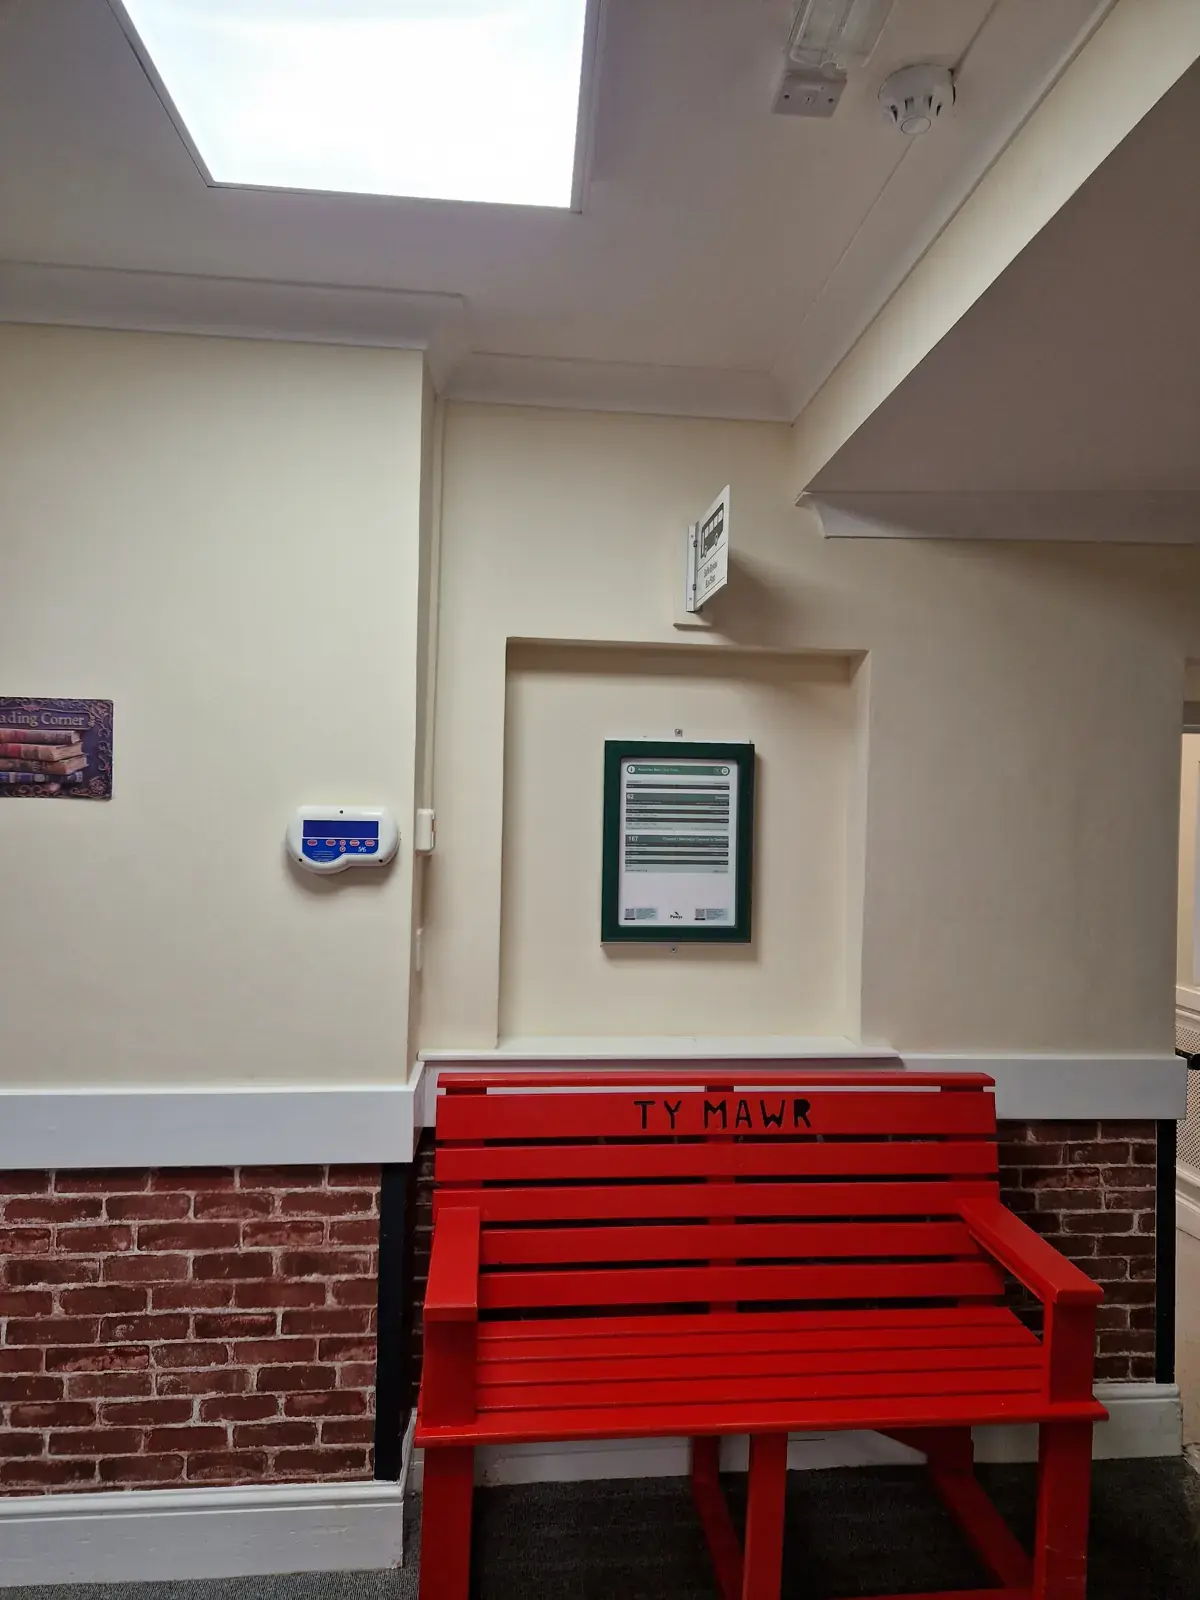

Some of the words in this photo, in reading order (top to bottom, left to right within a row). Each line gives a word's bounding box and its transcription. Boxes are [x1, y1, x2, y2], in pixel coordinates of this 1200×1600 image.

[41, 712, 84, 726] Corner
[633, 1100, 682, 1130] TY
[704, 1098, 812, 1130] MAWR
